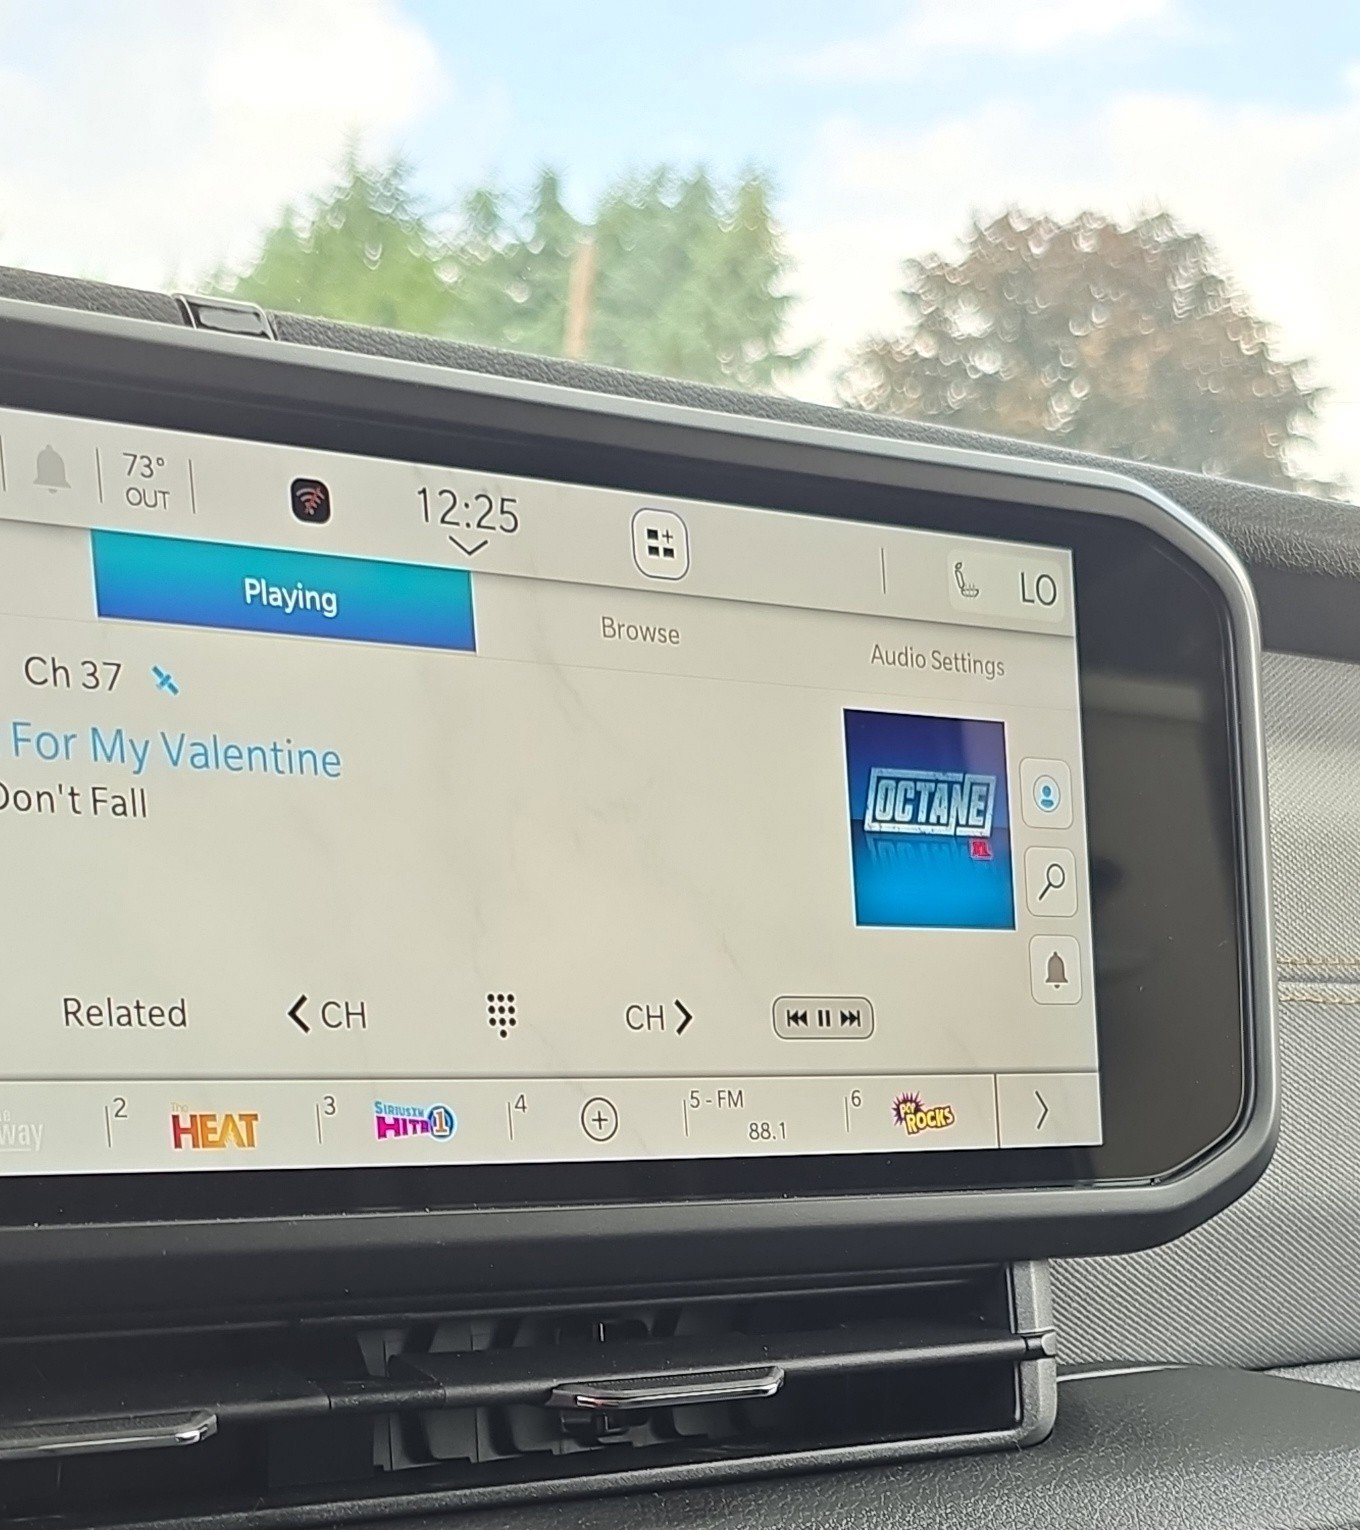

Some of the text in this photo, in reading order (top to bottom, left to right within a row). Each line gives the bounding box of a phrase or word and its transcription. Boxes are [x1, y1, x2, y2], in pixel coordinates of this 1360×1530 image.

[125, 487, 171, 512] OUT
[417, 486, 520, 534] 12:25
[243, 577, 339, 618] Playing
[1019, 571, 1058, 606] LO
[601, 616, 681, 646] Browse
[23, 655, 122, 692] Ch 37
[870, 644, 1006, 681] Audio Settings
[11, 721, 77, 762] For
[90, 726, 151, 776] My
[160, 731, 342, 778] Valentine
[91, 787, 148, 819] Fall
[873, 778, 989, 827] OCTANE
[63, 997, 188, 1028] Related
[320, 1001, 368, 1029] CH
[625, 1004, 666, 1032] CH
[112, 1097, 129, 1119] 2
[323, 1096, 337, 1116] 3
[514, 1094, 528, 1114] 4
[690, 1090, 701, 1109] 5
[716, 1089, 745, 1109] FM
[851, 1089, 862, 1108] 6
[171, 1113, 259, 1149] HEAT
[748, 1120, 787, 1141] 88.1
[905, 1106, 954, 1134] ROCKS
